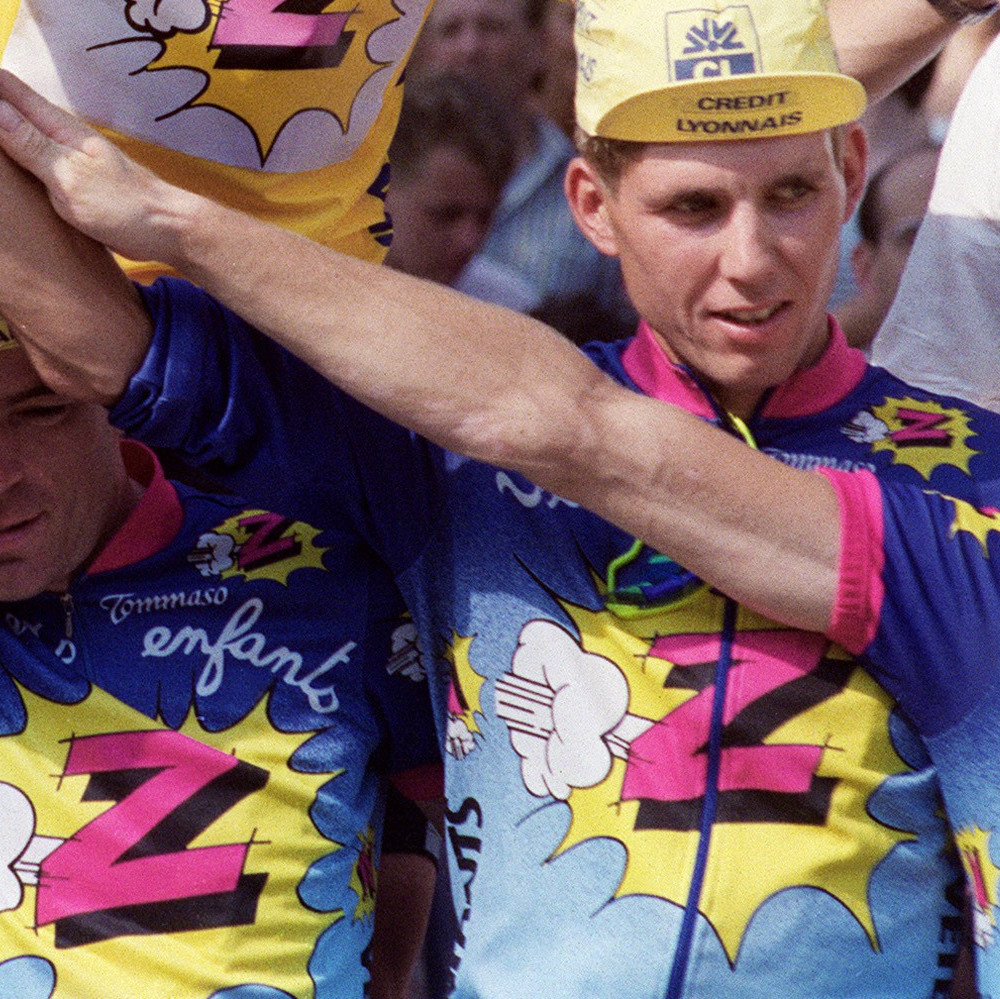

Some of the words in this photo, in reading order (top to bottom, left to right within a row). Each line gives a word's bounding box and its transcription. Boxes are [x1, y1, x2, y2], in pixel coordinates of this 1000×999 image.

[676, 111, 803, 133] LYONNAIS
[697, 91, 788, 110] CREDIT
[889, 407, 954, 448] Z
[236, 512, 302, 572] Z
[100, 586, 229, 625] Tommaso
[141, 598, 358, 714] enfants
[618, 630, 857, 832] Z
[36, 729, 269, 949] Z
